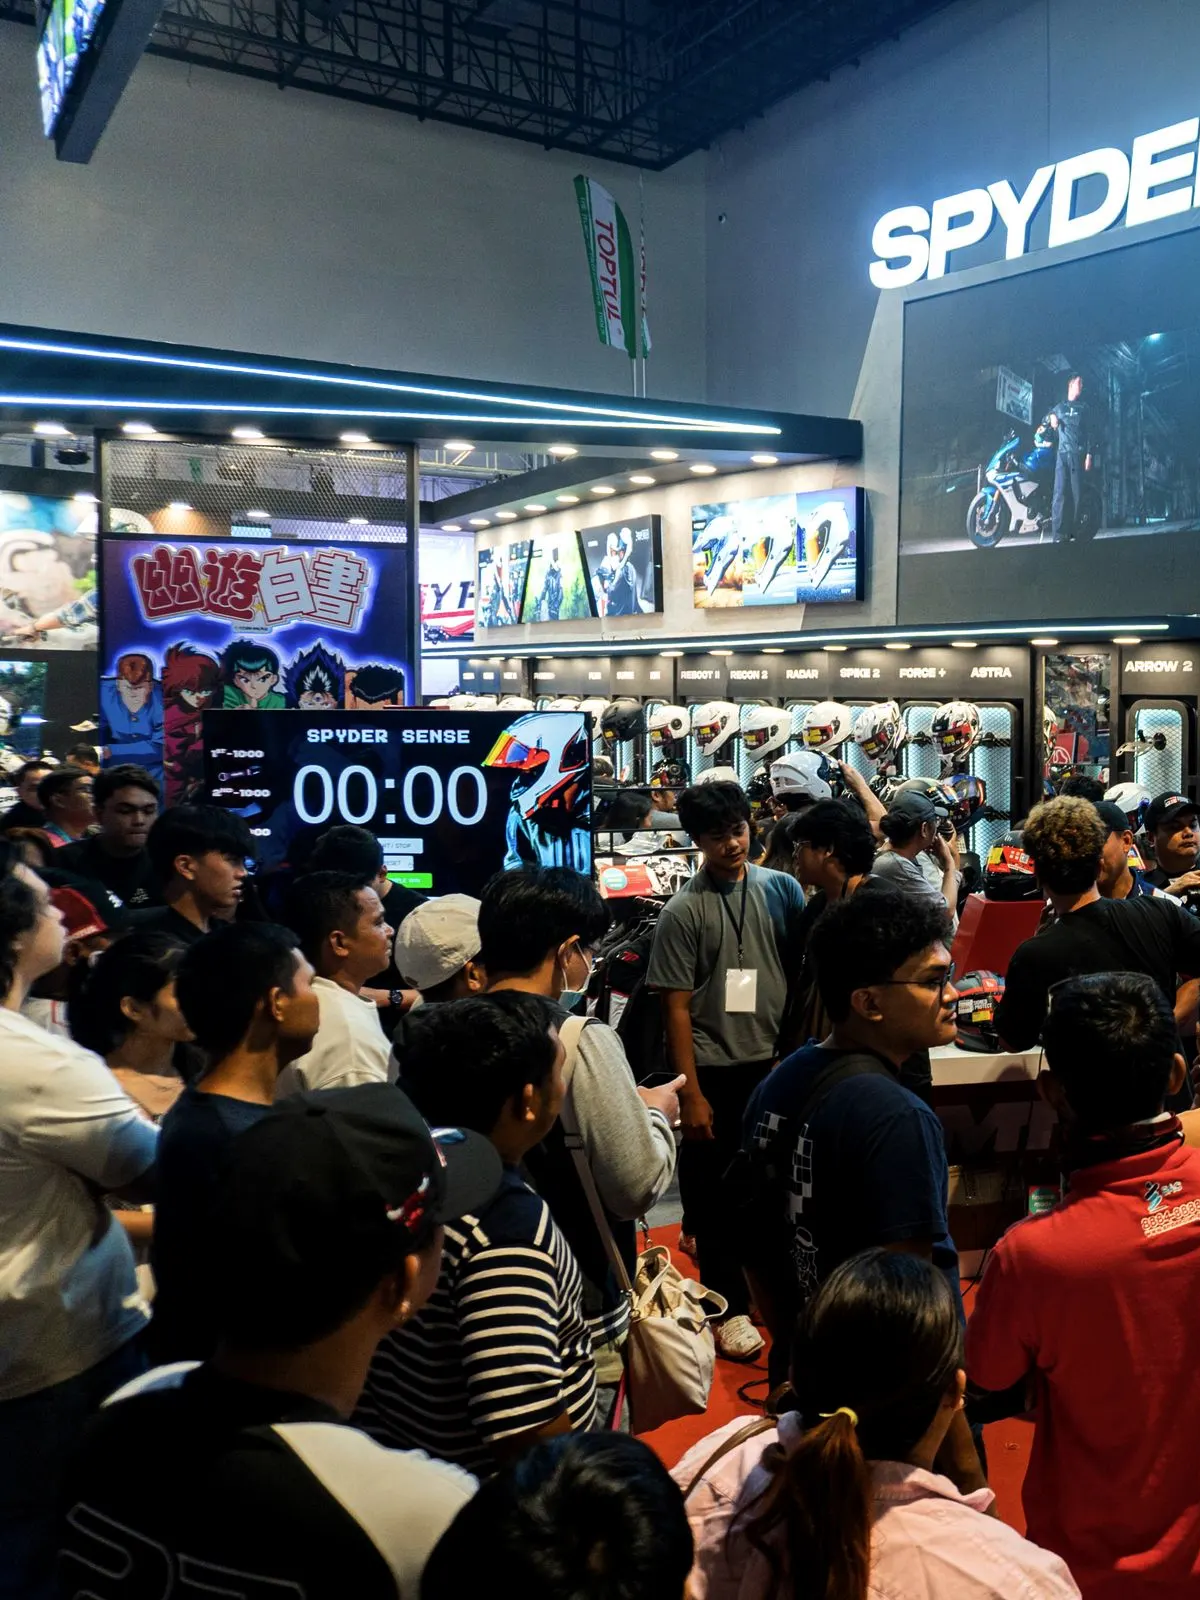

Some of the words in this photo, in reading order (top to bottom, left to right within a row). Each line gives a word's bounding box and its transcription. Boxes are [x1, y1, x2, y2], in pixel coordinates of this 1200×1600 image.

[595, 218, 622, 321] TOPTUL
[970, 666, 1012, 679] ASTRA
[1124, 660, 1178, 673] ARROW
[1182, 660, 1193, 672] 2
[680, 670, 713, 680] REBOOT
[730, 670, 760, 680] RECON
[761, 670, 768, 679] 2
[786, 669, 819, 680] RADAR
[840, 668, 870, 679] SPIKE
[872, 667, 880, 678] 2
[899, 667, 936, 679] FORCE
[306, 728, 389, 744] SPYDER
[401, 729, 471, 744] SENSE
[293, 764, 488, 826] 00:00
